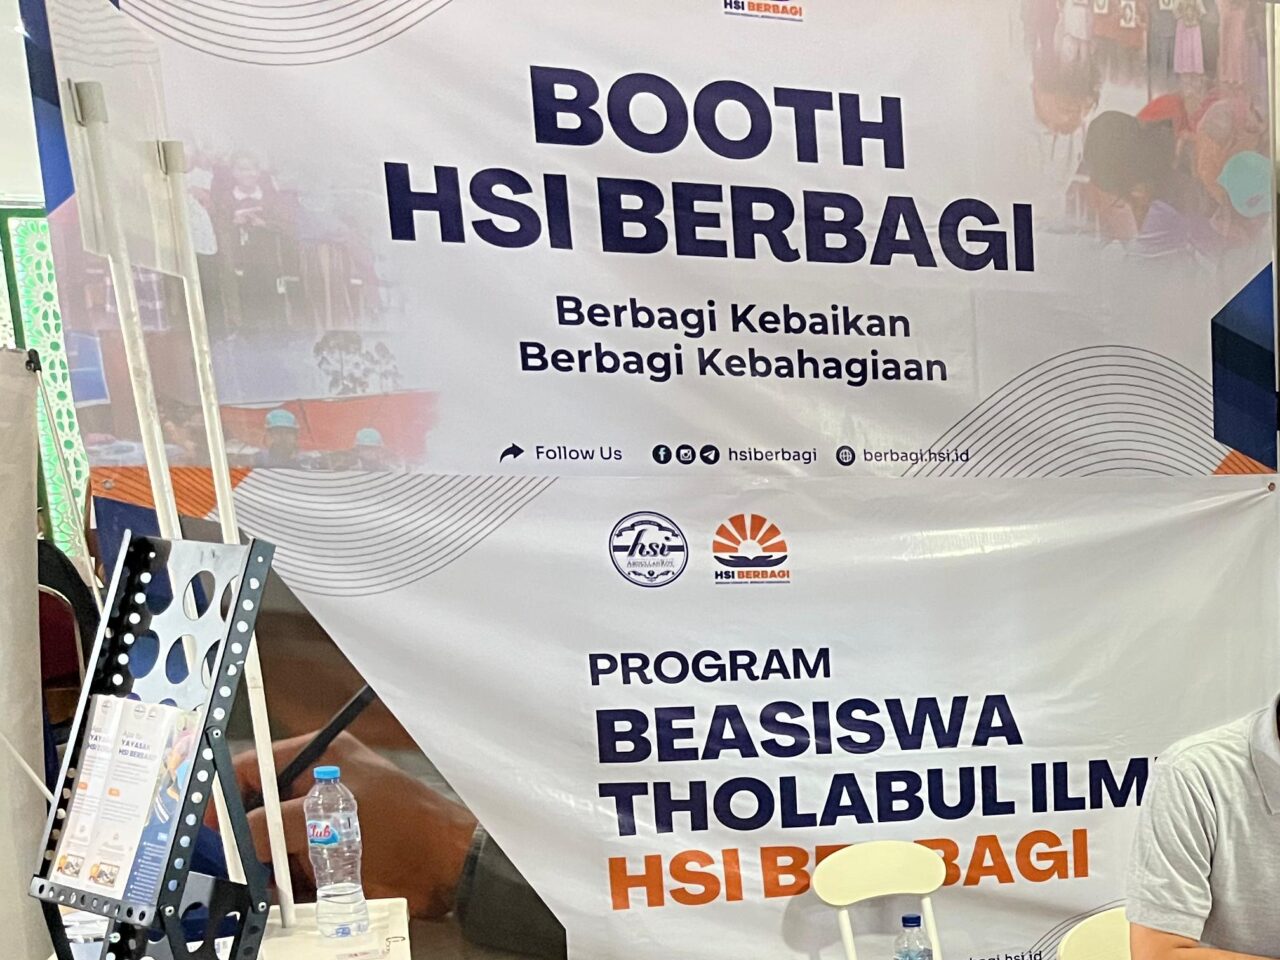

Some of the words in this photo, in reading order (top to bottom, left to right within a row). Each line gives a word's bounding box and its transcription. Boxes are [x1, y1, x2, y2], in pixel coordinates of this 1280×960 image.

[724, 0, 744, 10] HSI
[747, 1, 803, 16] BERBAGI
[529, 65, 906, 169] BOOTH
[383, 161, 574, 250] HSI
[597, 176, 1036, 272] BERBAGI
[556, 295, 717, 334] Berbagi
[730, 303, 911, 338] Kebaikan
[519, 341, 684, 380] Berbagi
[697, 347, 948, 386] Kebahagiaan
[536, 445, 594, 460] Follow
[599, 446, 623, 461] Us
[728, 447, 817, 464] hsiberbagi
[864, 448, 969, 464] berbagi.hsi.id
[628, 529, 671, 557] hsi
[715, 570, 735, 579] HSI
[737, 570, 790, 579] BERBAGI
[588, 647, 831, 686] PROGRAM
[596, 694, 1024, 764] BEASISWA
[599, 766, 1016, 837] THOLABUL
[1031, 757, 1158, 813] ILM
[608, 848, 743, 910] HSI
[760, 829, 1089, 898] BAGI
